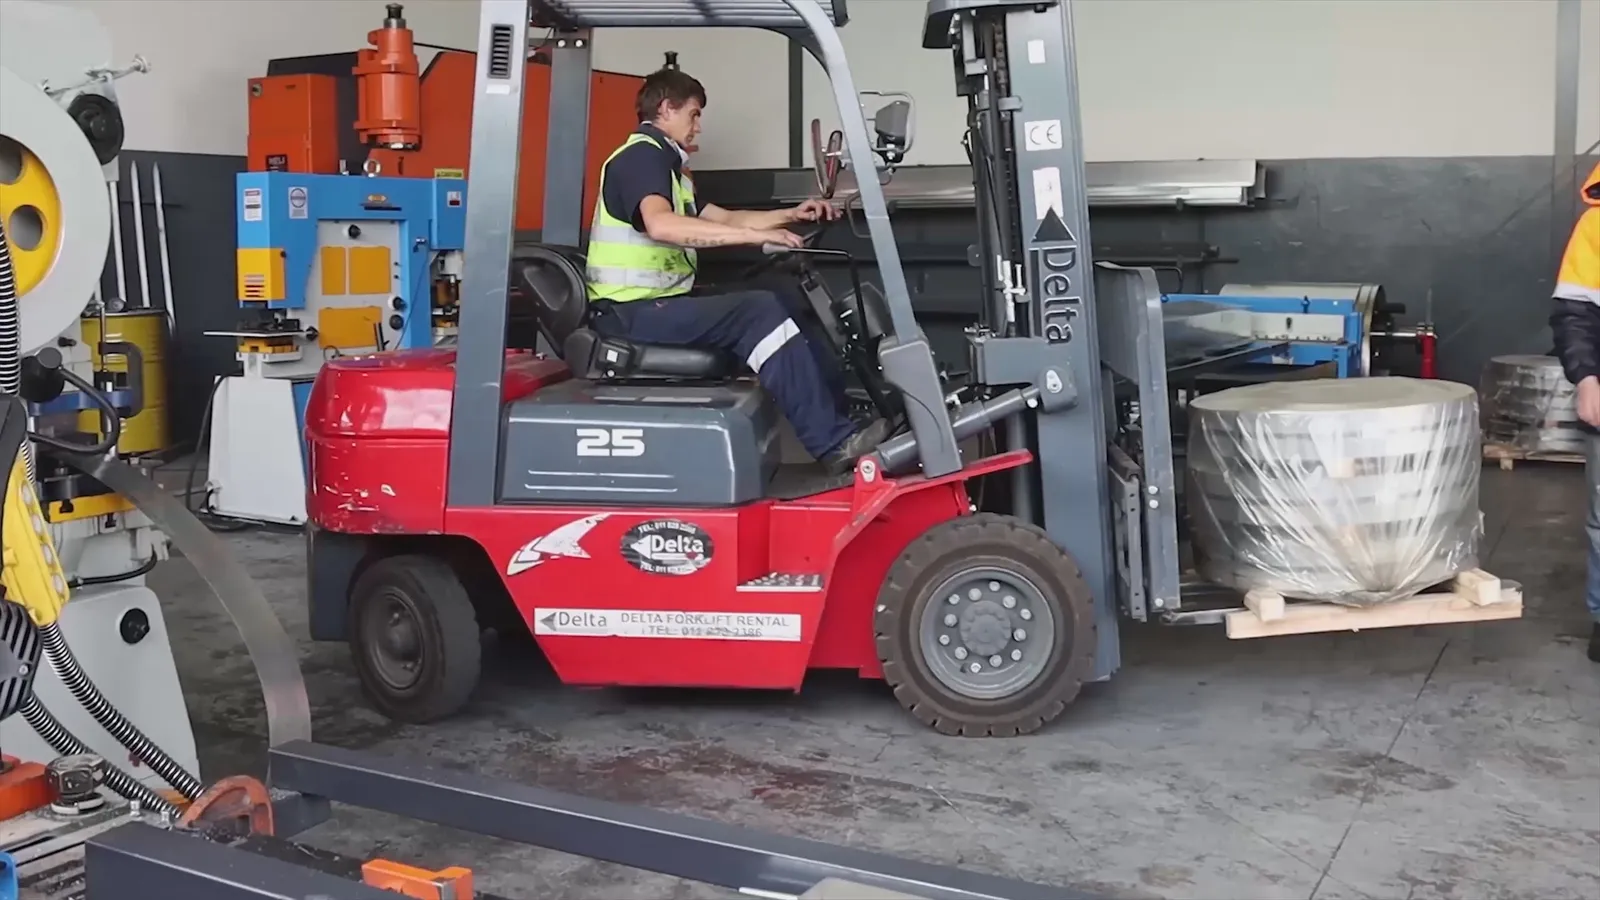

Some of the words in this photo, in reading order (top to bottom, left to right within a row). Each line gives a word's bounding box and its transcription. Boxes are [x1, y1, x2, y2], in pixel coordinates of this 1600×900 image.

[1030, 123, 1057, 145] CE
[1042, 244, 1081, 345] Delta
[576, 428, 645, 457] 25
[651, 534, 704, 553] Delta
[558, 611, 608, 627] Delta
[621, 612, 663, 625] DELTA
[666, 613, 733, 627] FORKLIFT
[737, 615, 789, 628] RENTAL
[682, 626, 702, 636] 011
